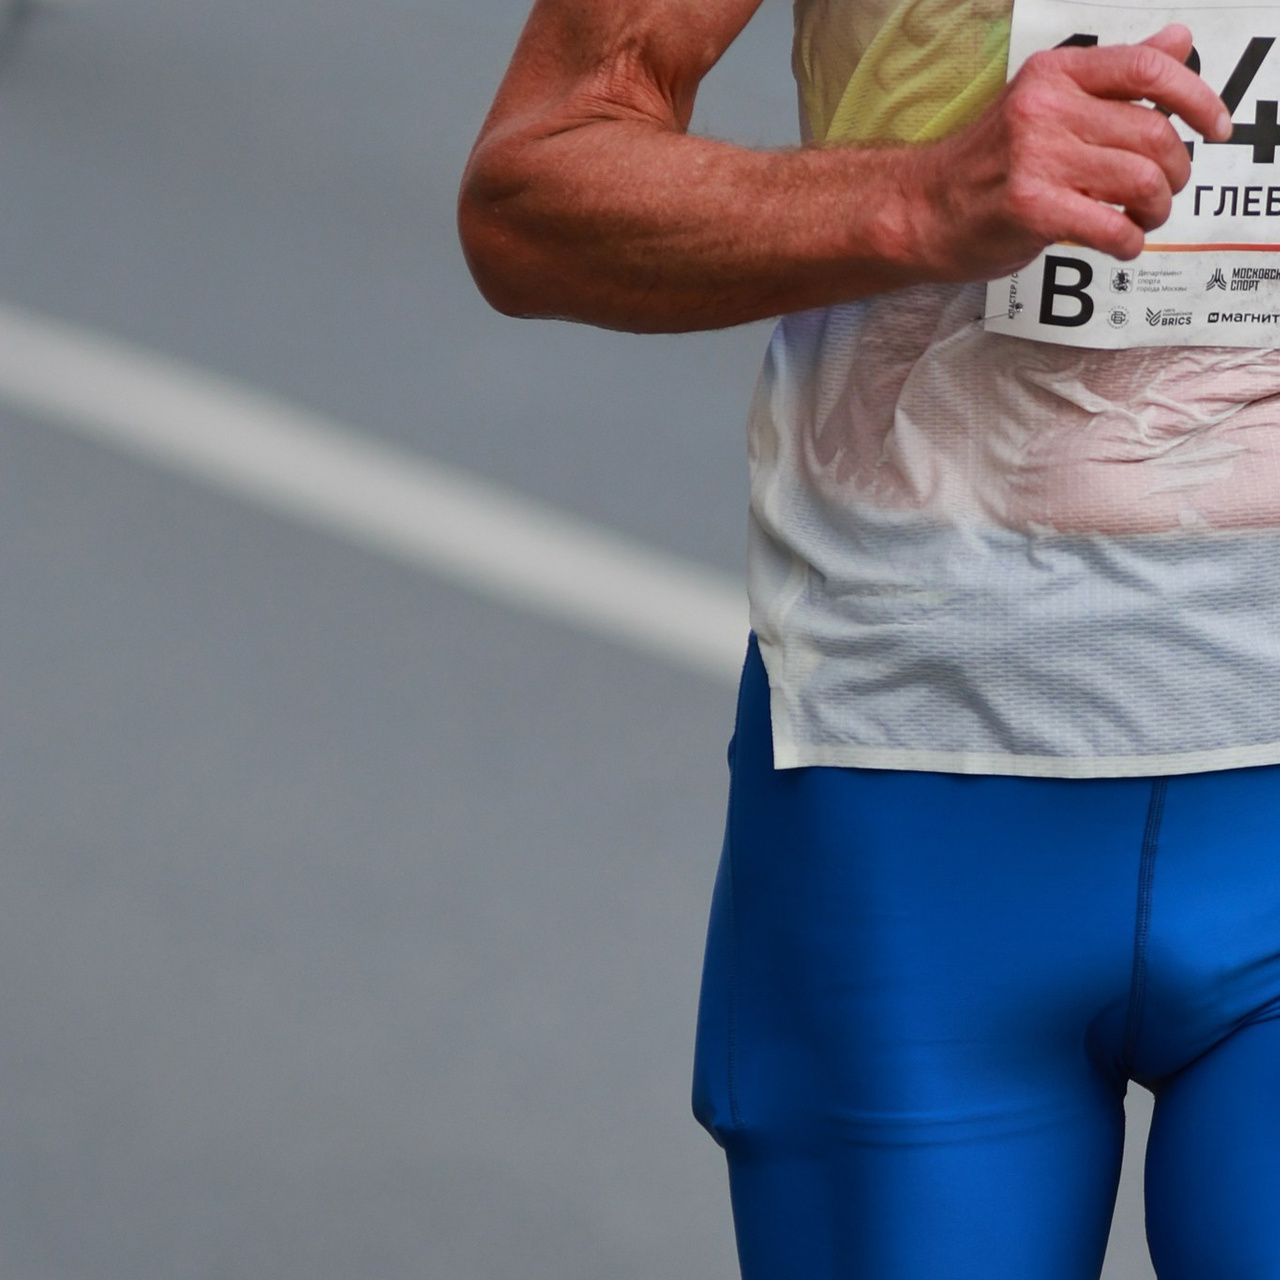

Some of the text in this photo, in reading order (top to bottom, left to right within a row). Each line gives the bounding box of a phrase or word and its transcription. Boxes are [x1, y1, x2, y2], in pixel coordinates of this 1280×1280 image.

[1039, 254, 1094, 327] B
[1230, 280, 1260, 292] СПОРТ
[1161, 316, 1192, 326] BRICS
